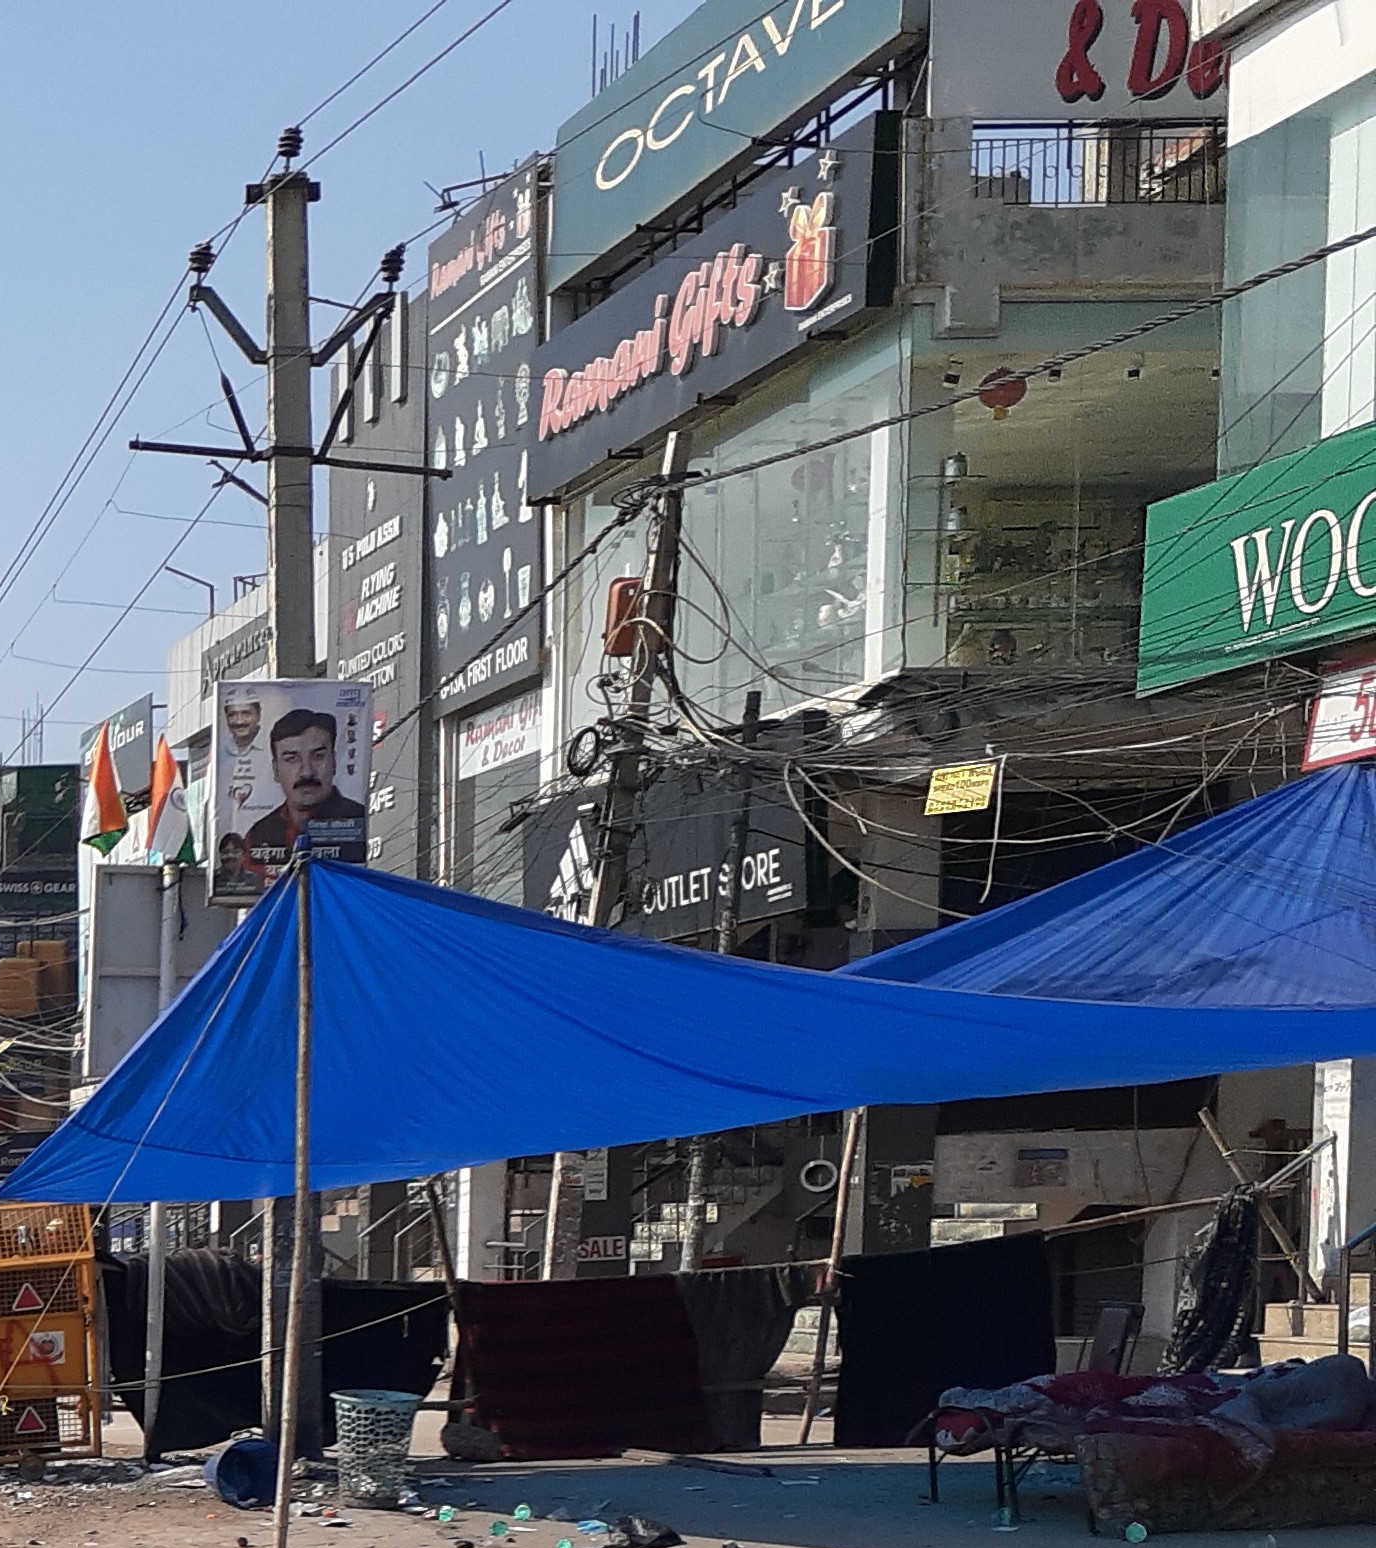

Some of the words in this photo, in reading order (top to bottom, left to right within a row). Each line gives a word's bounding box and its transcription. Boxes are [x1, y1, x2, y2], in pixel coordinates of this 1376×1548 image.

[1056, 0, 1105, 103] &
[1127, 0, 1231, 99] De
[539, 295, 668, 441] Ramani
[669, 243, 763, 376] Gifts
[361, 562, 396, 600] FLYING
[356, 584, 401, 629] MACHINE
[372, 631, 405, 664] COLORS
[468, 653, 492, 687] FIRST
[495, 637, 528, 674] FLOOR
[44, 881, 76, 893] GEAR
[643, 867, 712, 914] OUTLET
[719, 848, 781, 896] SORE
[576, 1239, 623, 1258] SALE
